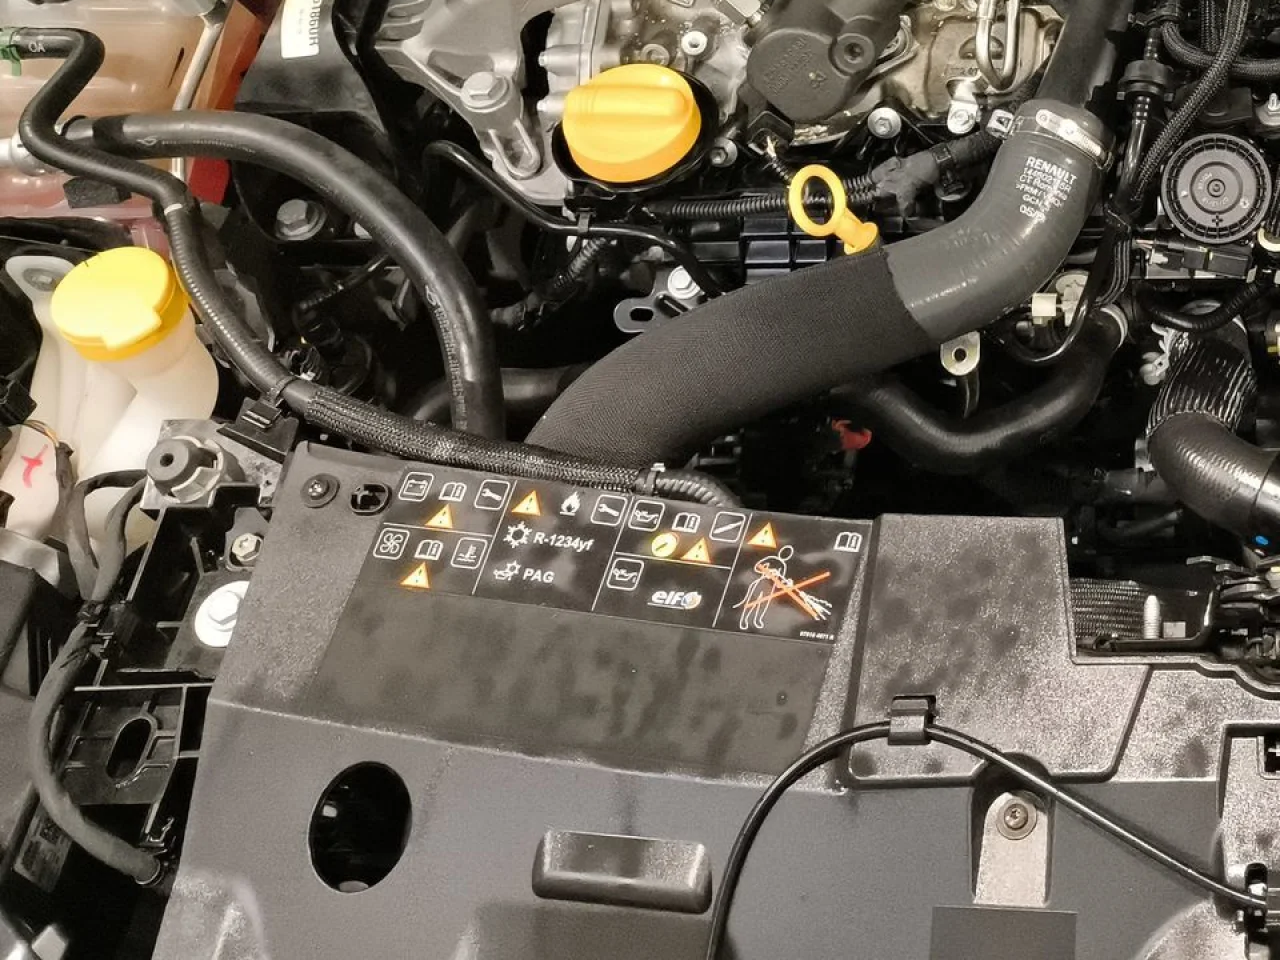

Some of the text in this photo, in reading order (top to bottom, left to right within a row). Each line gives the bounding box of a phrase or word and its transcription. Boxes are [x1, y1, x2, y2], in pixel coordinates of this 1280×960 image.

[1026, 156, 1077, 185] RENAULT
[533, 531, 595, 553] R-1234yf
[523, 568, 555, 583] PAG
[651, 590, 685, 606] elf
